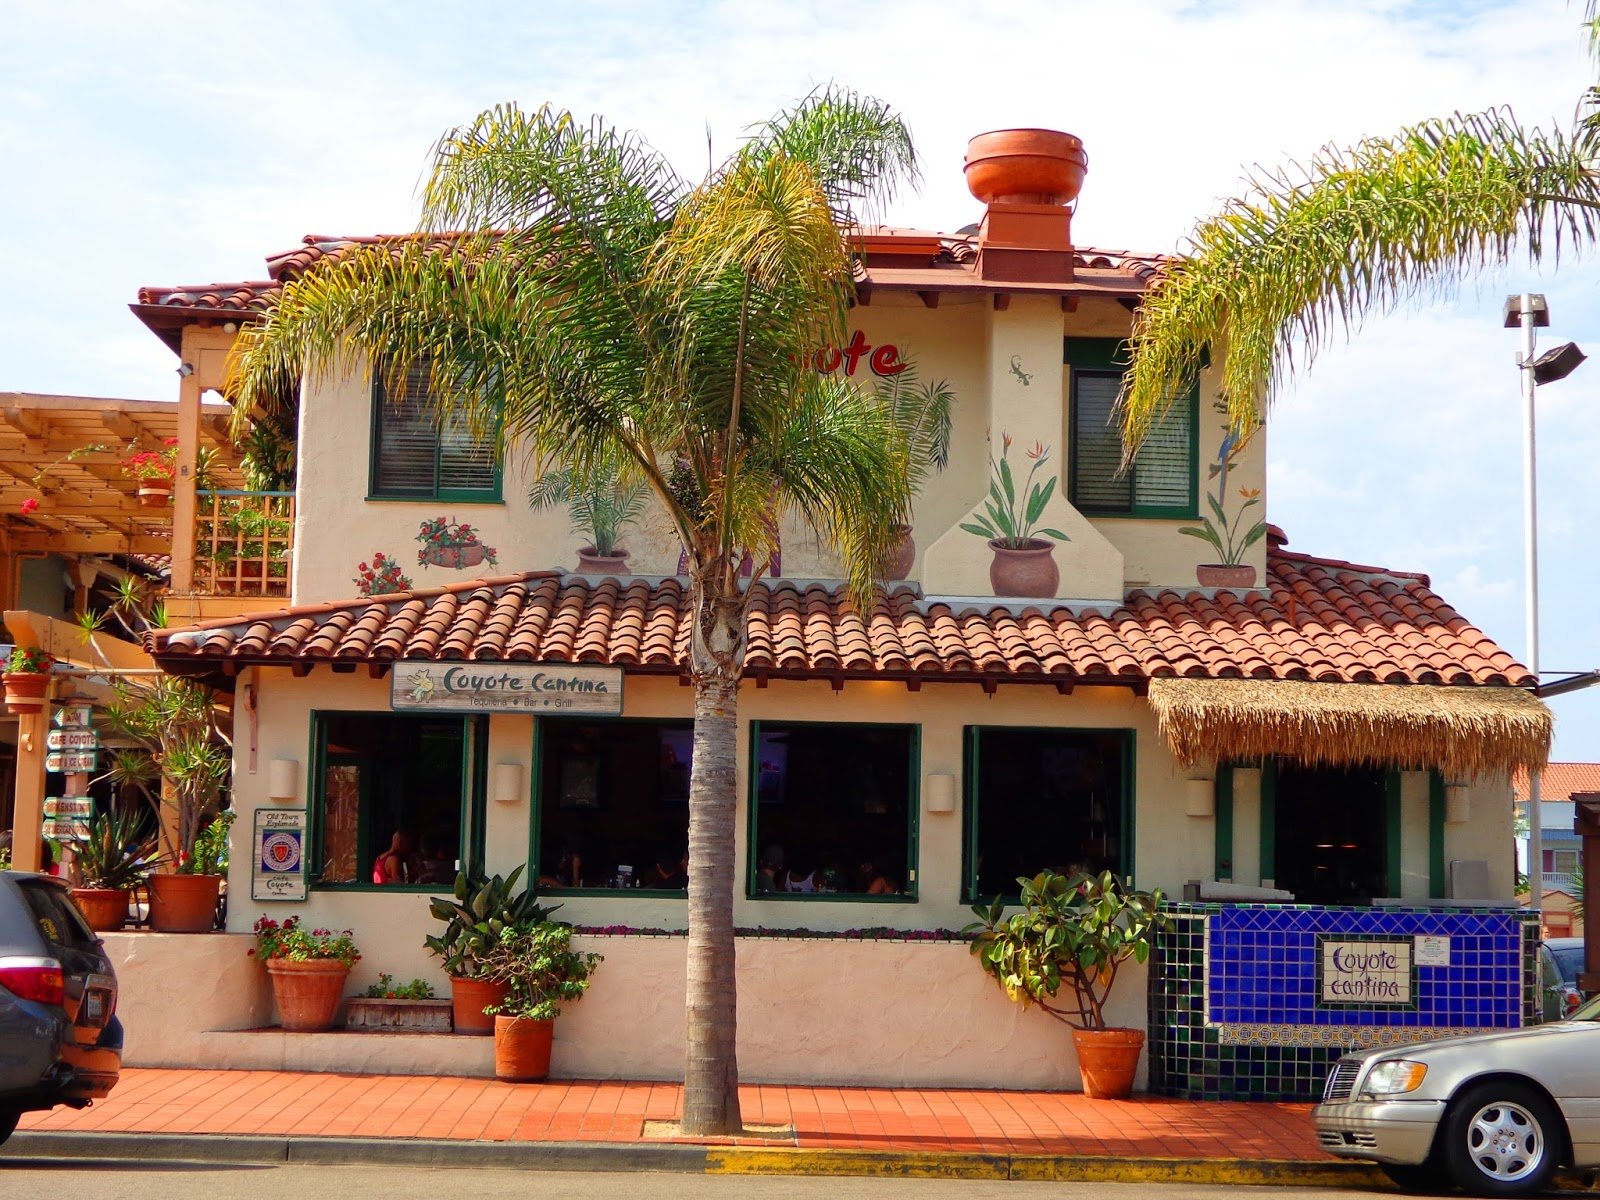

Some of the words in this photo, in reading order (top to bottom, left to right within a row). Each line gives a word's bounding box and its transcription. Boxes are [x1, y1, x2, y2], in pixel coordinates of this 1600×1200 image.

[443, 666, 524, 694] Coyote
[531, 672, 608, 693] Cantina
[524, 697, 537, 707] Bar
[554, 698, 572, 708] Grill
[51, 735, 66, 744] CAFE
[70, 735, 95, 744] COYOTE
[266, 879, 294, 890] Coyote
[1333, 946, 1399, 977] Coyote
[1331, 976, 1400, 997] cantina
